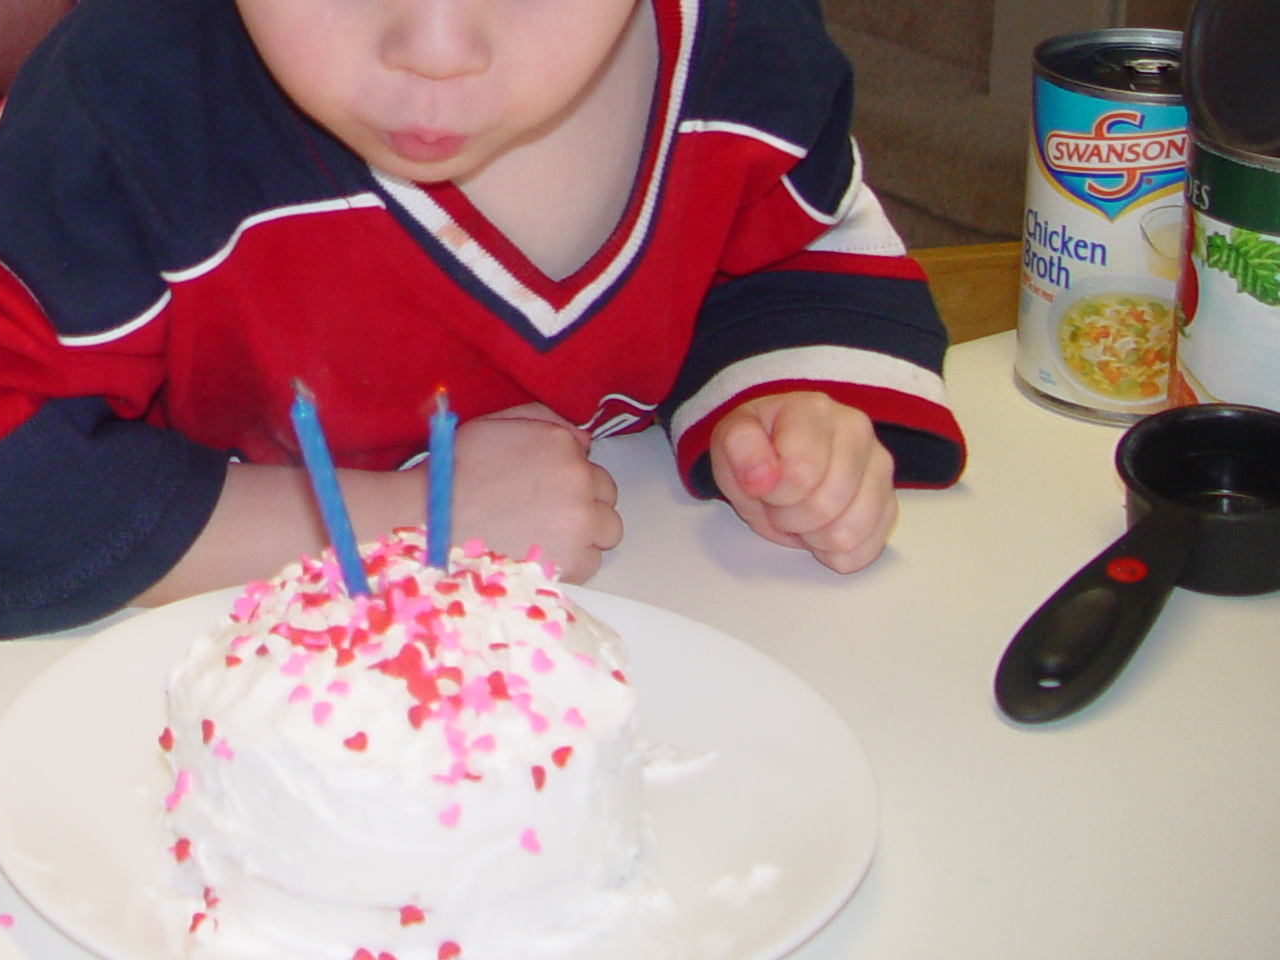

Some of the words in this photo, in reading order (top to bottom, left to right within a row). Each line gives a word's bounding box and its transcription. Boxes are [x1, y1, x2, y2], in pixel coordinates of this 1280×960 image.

[1053, 136, 1188, 164] SWANSON
[1026, 208, 1108, 267] Chicken
[1023, 238, 1071, 290] Broth
